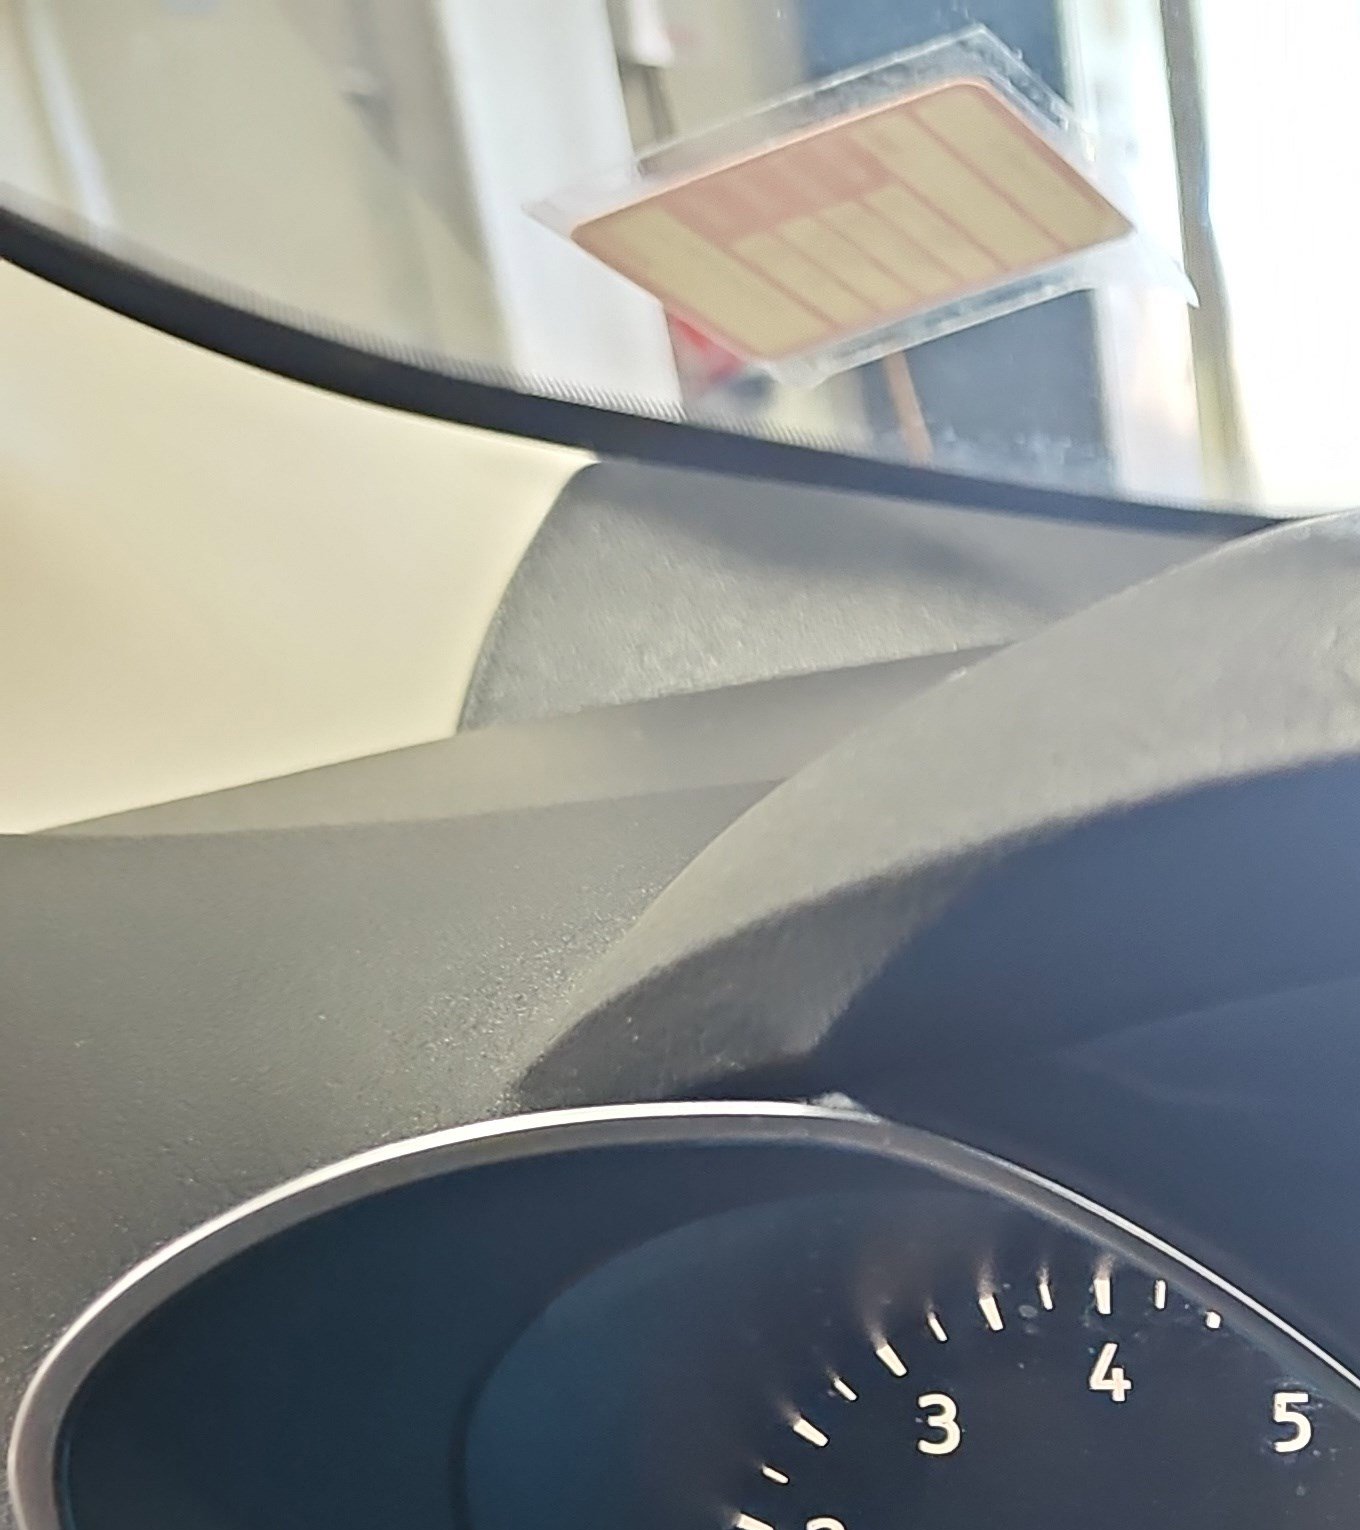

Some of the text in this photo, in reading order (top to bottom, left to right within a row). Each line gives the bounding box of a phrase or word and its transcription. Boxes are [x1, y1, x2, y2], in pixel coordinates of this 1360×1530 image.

[1089, 1343, 1132, 1402] 4
[918, 1393, 961, 1455] 3
[1273, 1392, 1312, 1453] 5
